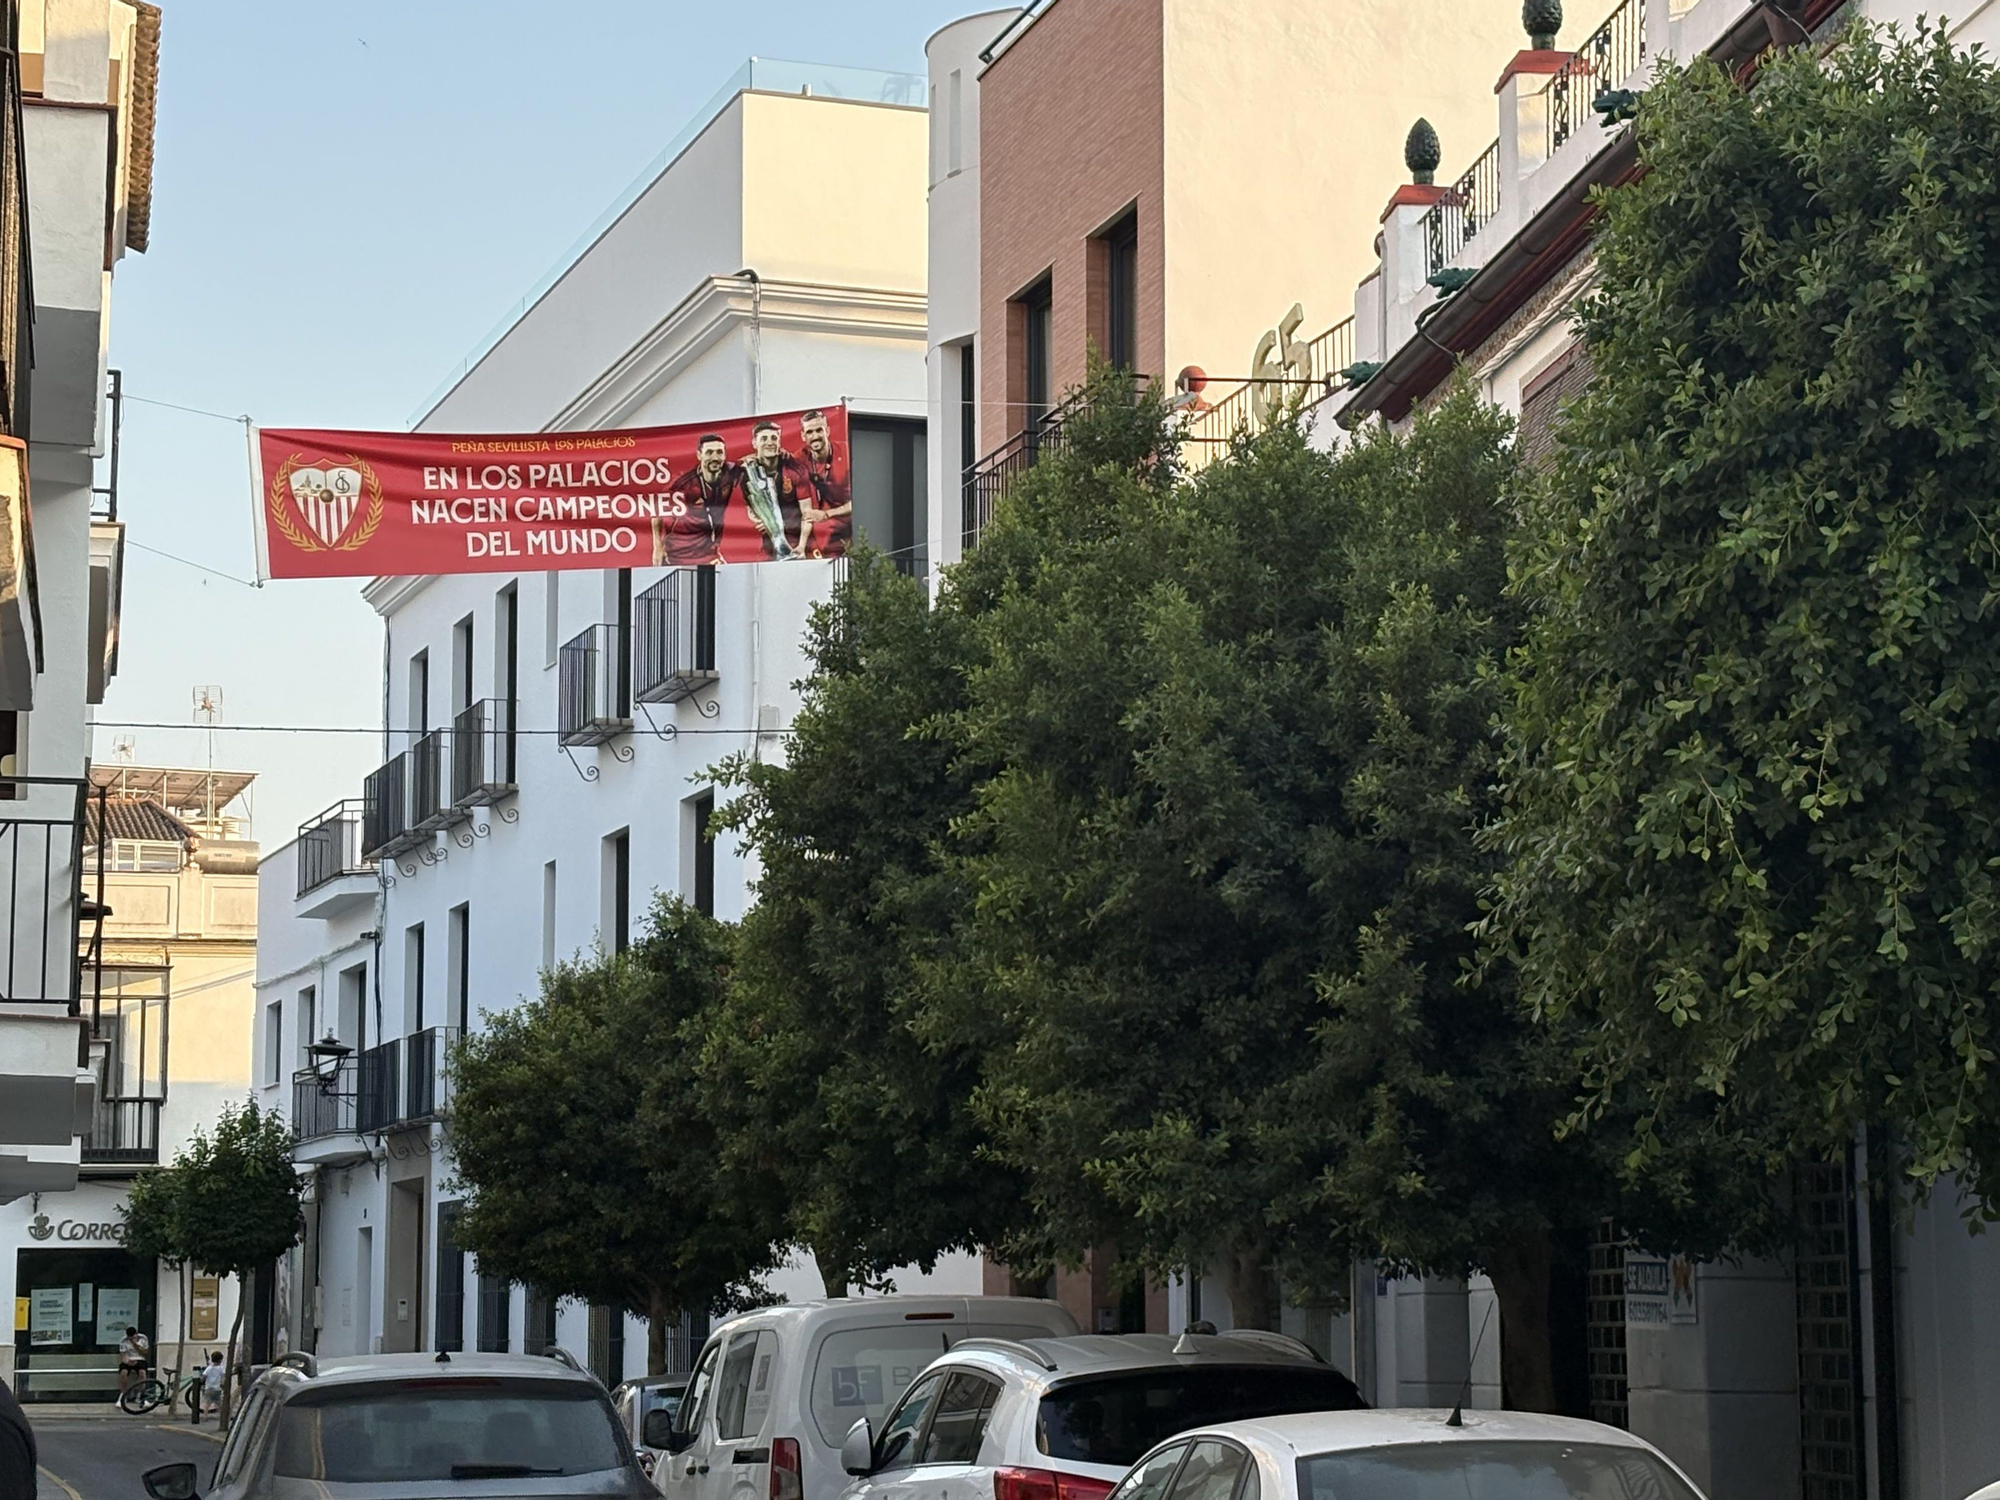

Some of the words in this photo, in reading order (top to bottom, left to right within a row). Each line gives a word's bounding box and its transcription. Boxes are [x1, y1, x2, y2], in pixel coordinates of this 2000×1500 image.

[452, 440, 486, 453] PEÑA
[487, 440, 550, 453] SEVILLISTA
[576, 436, 636, 450] PALACIOS
[424, 467, 459, 490] EN
[466, 464, 522, 490] LOS
[530, 458, 671, 489] PALACIOS
[411, 497, 508, 525] NACEN
[514, 491, 688, 522] CAMPEONES
[466, 531, 521, 558] DEL
[526, 527, 637, 556] MUNDO
[57, 1219, 130, 1241] CORRE
